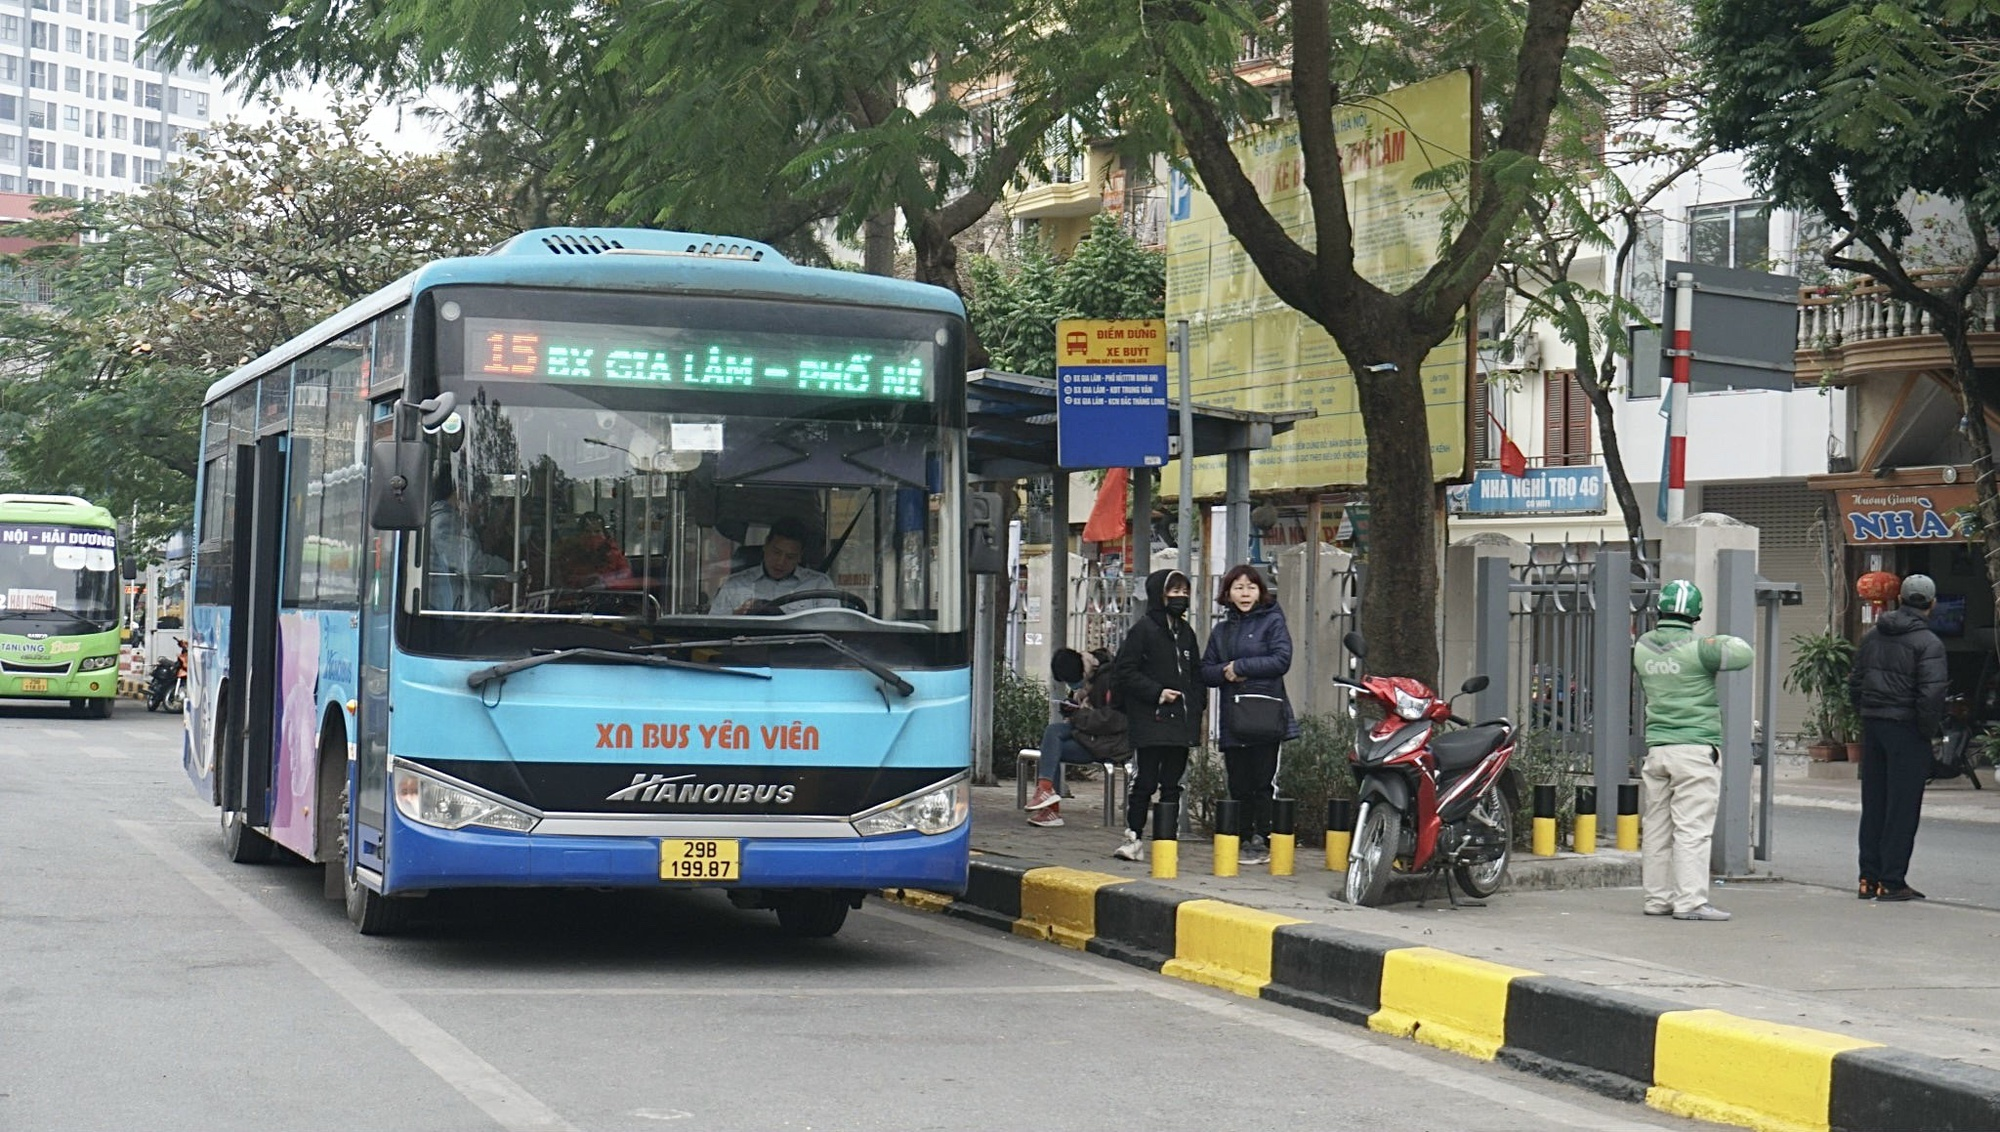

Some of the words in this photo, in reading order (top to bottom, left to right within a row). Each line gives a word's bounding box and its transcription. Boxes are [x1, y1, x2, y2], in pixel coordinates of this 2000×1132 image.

[1097, 326, 1124, 340] ĐIỂM
[1106, 347, 1120, 357] XE
[484, 333, 539, 375] 15
[548, 346, 594, 378] BX
[606, 350, 672, 382] GIA
[684, 345, 754, 387] LÂM
[799, 353, 873, 393] PHỐ
[1481, 475, 1509, 499] NHÀ
[1511, 472, 1546, 498] NGHỈ
[1549, 476, 1577, 500] TRỌ
[1578, 476, 1600, 496] 46
[1848, 497, 1953, 540] NHÀ
[3, 528, 28, 545] NỘI
[41, 528, 65, 544] HẢI
[68, 532, 116, 548] DƯƠNG
[1644, 656, 1681, 675] Grab
[595, 722, 634, 749] XN
[642, 723, 691, 750] BUS
[698, 718, 750, 750] YÊN
[760, 719, 820, 751] VIÊN
[683, 841, 717, 859] 29B
[671, 860, 731, 878] 199.87
